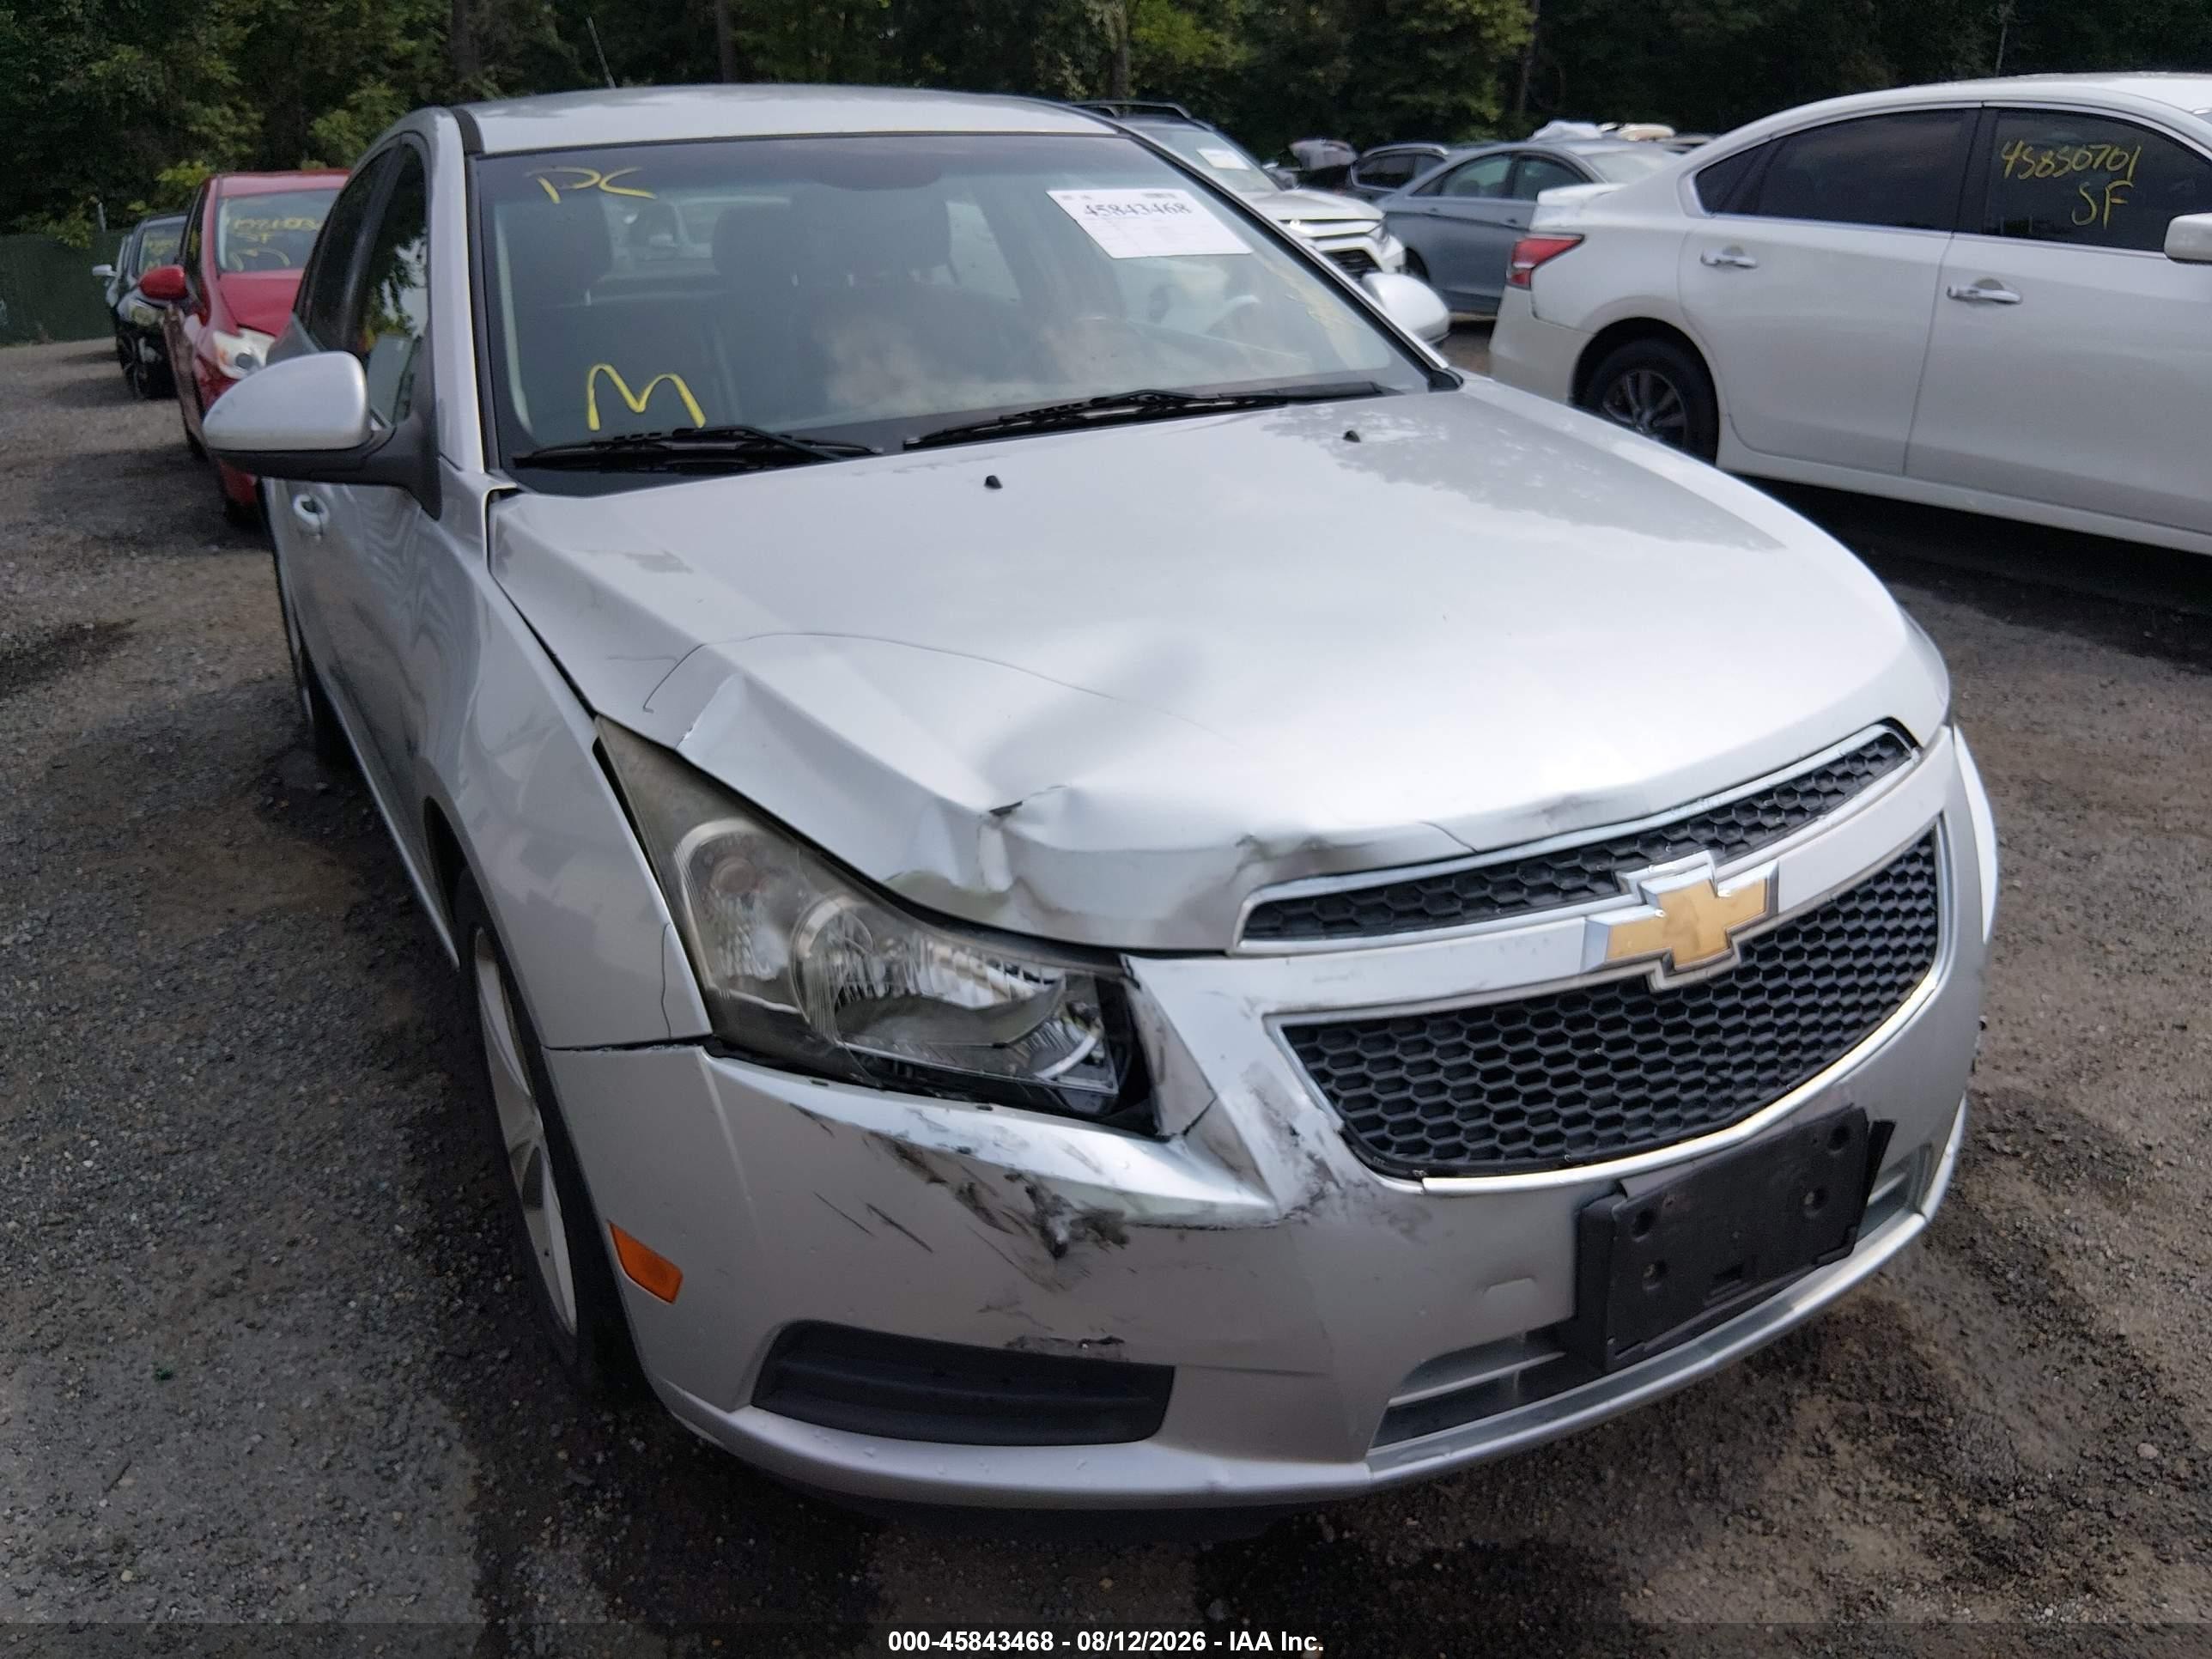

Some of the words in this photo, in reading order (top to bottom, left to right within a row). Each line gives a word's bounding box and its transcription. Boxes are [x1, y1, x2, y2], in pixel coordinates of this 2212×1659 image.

[1083, 202, 1193, 217] 45843468
[2070, 179, 2135, 230] SF
[587, 362, 707, 432] M
